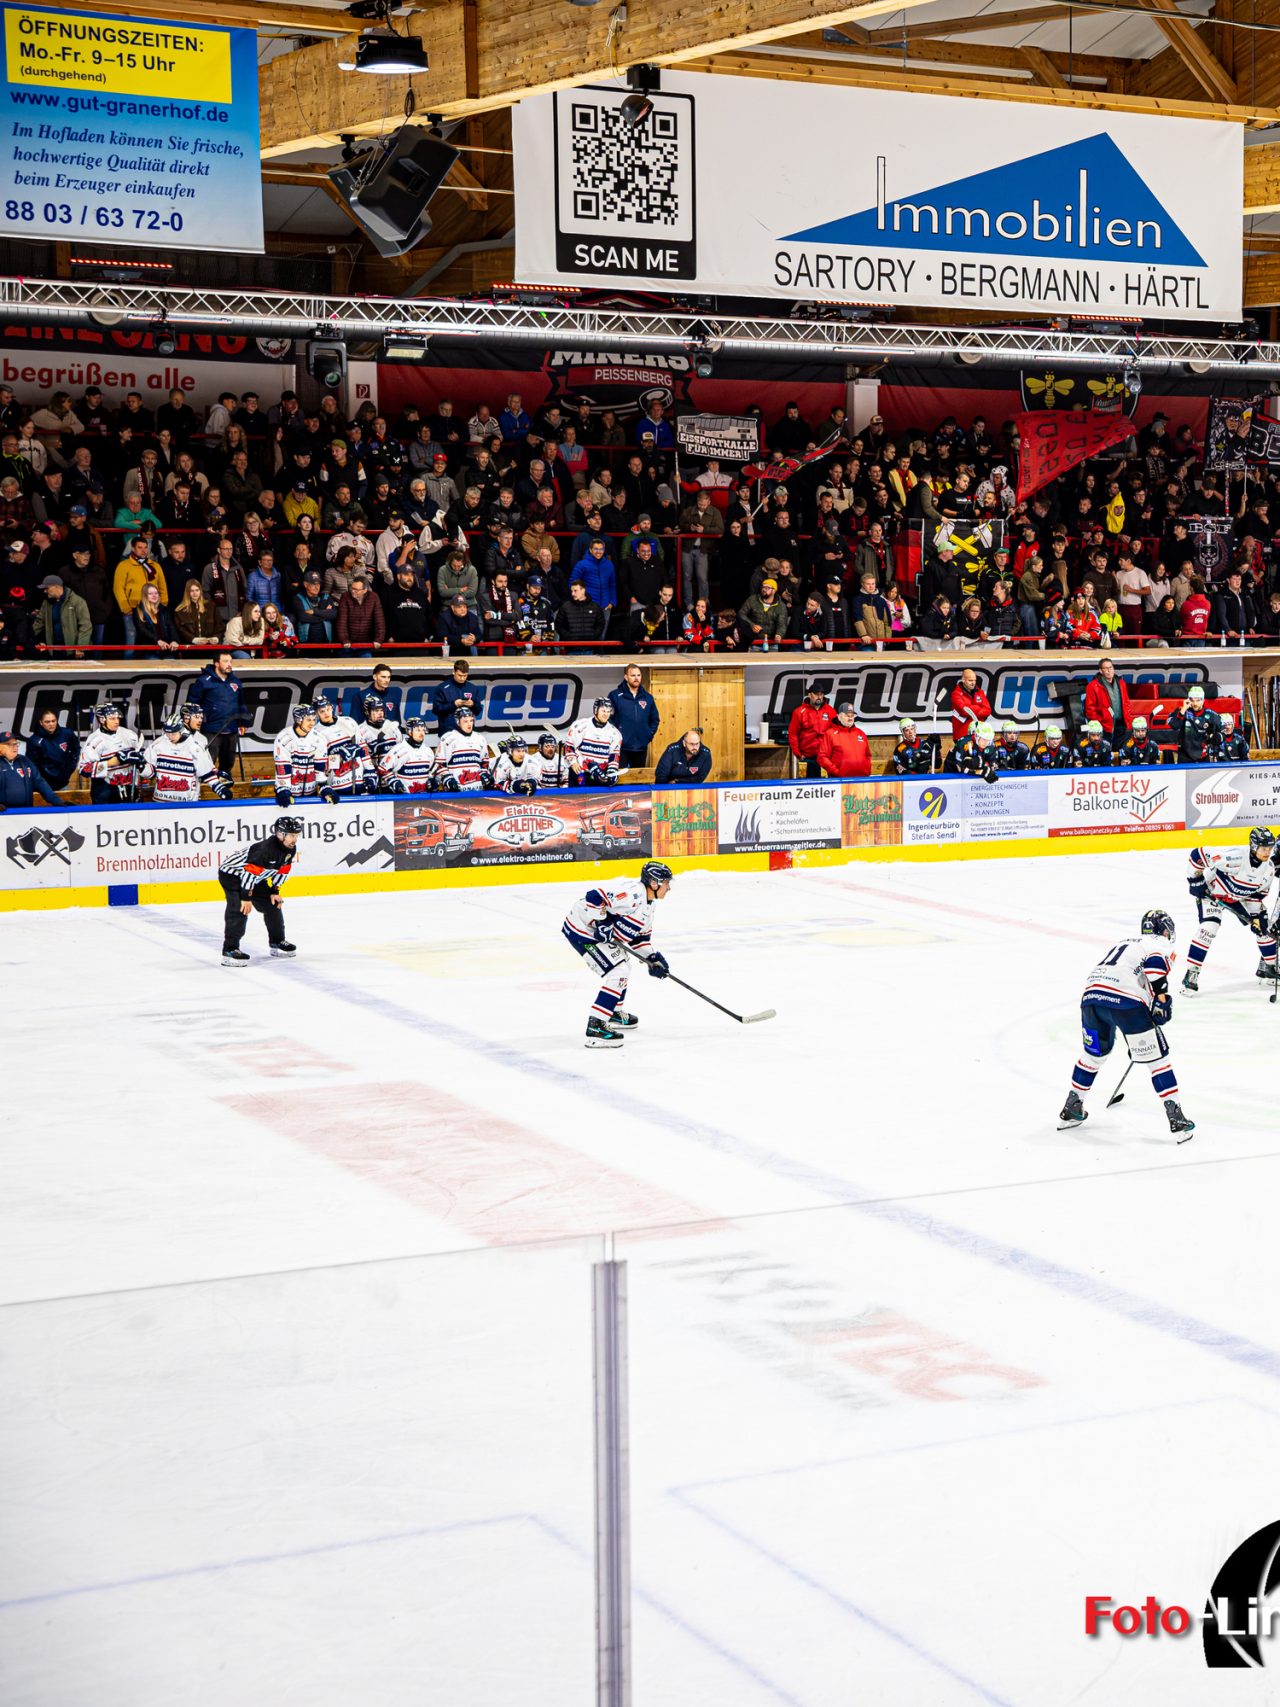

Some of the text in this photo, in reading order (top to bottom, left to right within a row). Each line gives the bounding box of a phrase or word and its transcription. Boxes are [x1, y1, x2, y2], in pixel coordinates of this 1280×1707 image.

[18, 15, 204, 52] ÖFFNUNGSZEITEN:
[19, 42, 85, 64] Mo.-Fr.
[143, 55, 175, 72] Uhr
[20, 65, 106, 84] (durchgehend)
[10, 90, 229, 123] www.gut-granerhof.de
[12, 122, 244, 159] Im Hofladen können Sie frische,
[13, 147, 210, 176] hochwertige Qualität direkt
[14, 171, 195, 199] beim Erzeuger einkaufen
[877, 155, 1161, 250] Immobilien
[43, 203, 73, 224] 03
[95, 207, 124, 227] 63
[132, 209, 183, 232] 72-0
[574, 242, 679, 272] SCAN ME
[774, 250, 1210, 310] SARTORY BERGMANN HÄRTL
[2, 358, 196, 391] begrüßen alle
[595, 369, 672, 387] PEISSENBERG
[724, 787, 836, 803] Feuerraum Zeitler
[970, 783, 1028, 791] ENERGIETECHNISCHE
[1066, 775, 1151, 798] Janetzky
[1073, 797, 1129, 811] Balkone
[1195, 792, 1240, 805] Strohmaier
[1251, 798, 1277, 807] ROLF
[506, 806, 545, 816] Elektro
[776, 809, 799, 817] Kamine
[498, 818, 554, 832] ACHLEITNER
[775, 818, 809, 826] Kachelöfen
[908, 822, 960, 832] Ingenieurbüro
[911, 831, 935, 841] Stefan
[1059, 827, 1121, 837] www.balkonjanetzky.de
[735, 841, 826, 853] www.feuerraum-zeitler.de
[97, 852, 212, 873] Brennholzhandel
[478, 852, 573, 865] www.elektro-achleitner.de
